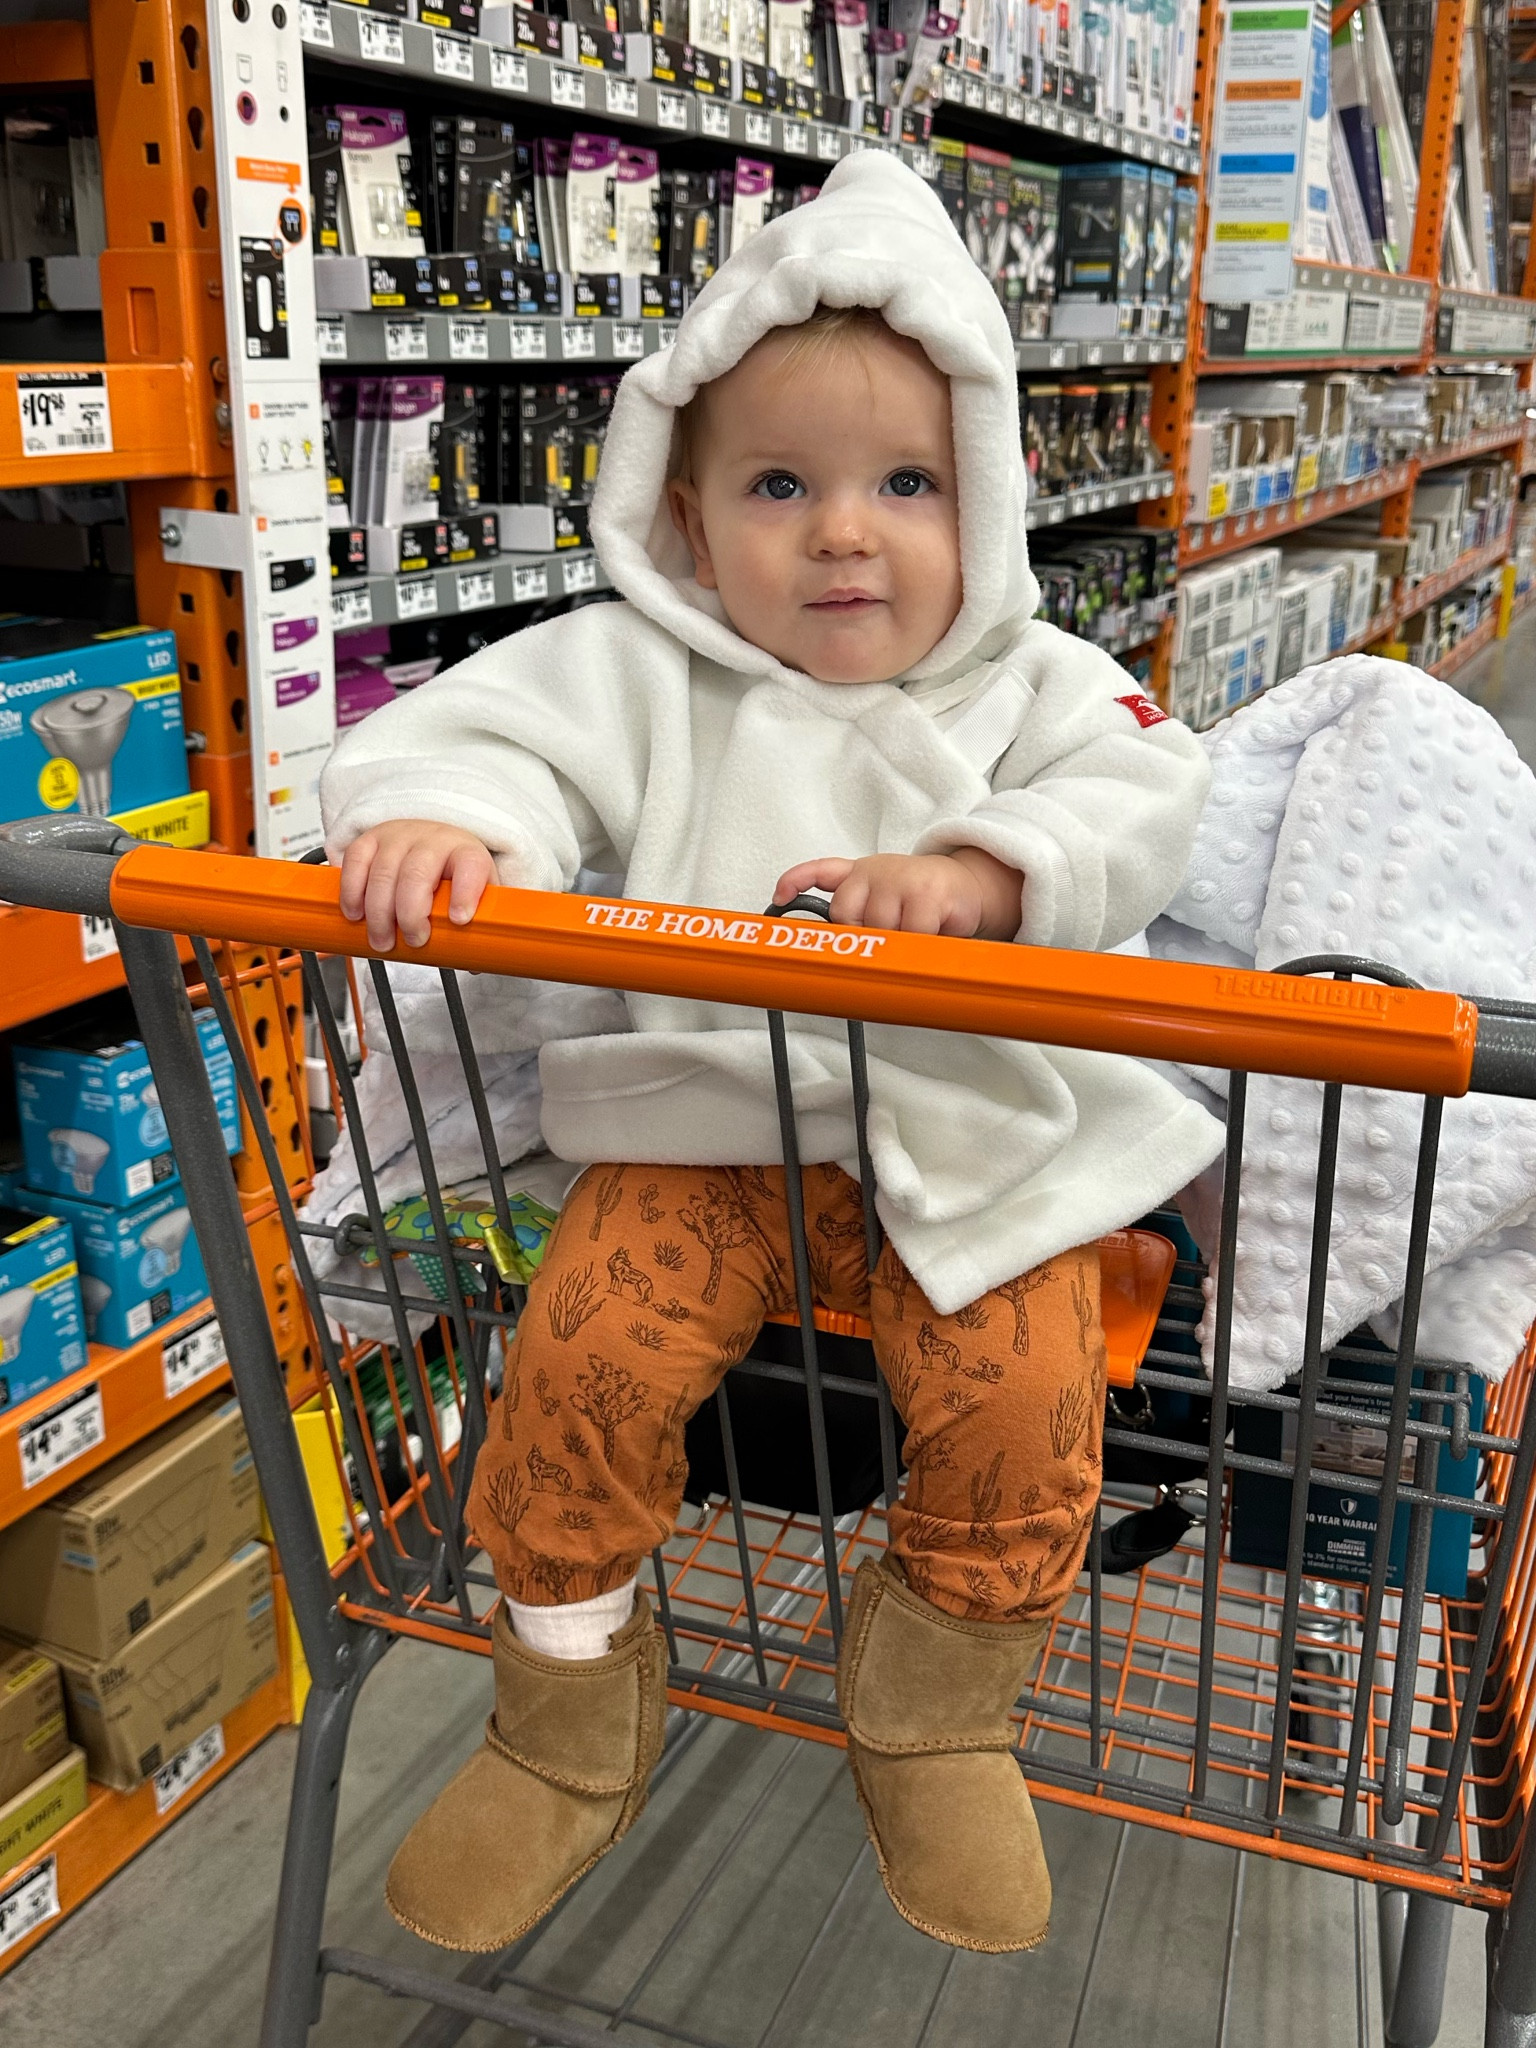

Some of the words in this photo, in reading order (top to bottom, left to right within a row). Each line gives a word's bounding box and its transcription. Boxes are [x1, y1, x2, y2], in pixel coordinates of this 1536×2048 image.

[147, 650, 171, 669] LED
[153, 816, 189, 838] WHITE
[585, 903, 653, 931] THE
[655, 911, 763, 944] HOME
[766, 925, 886, 957] DEPOT
[1317, 1514, 1341, 1526] YEAR
[1327, 1541, 1366, 1552] DIMMING
